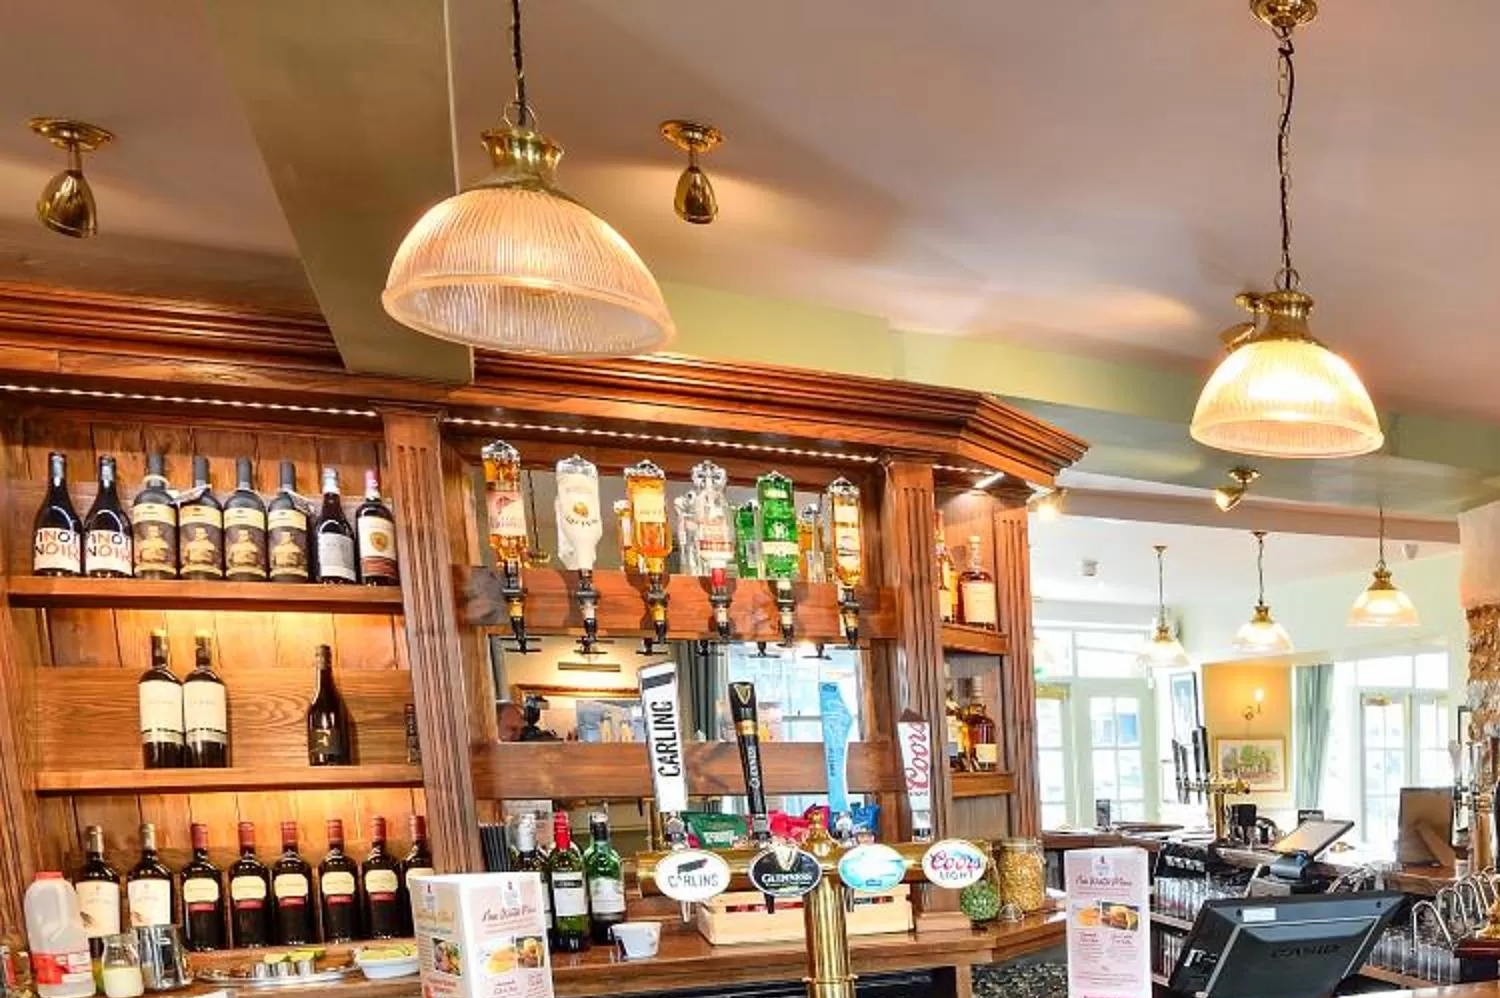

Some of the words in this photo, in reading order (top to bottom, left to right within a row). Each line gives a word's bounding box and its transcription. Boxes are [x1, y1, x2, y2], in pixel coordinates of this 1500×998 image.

[651, 700, 681, 778] CARLING
[904, 722, 929, 791] Coors
[929, 849, 982, 872] Coors
